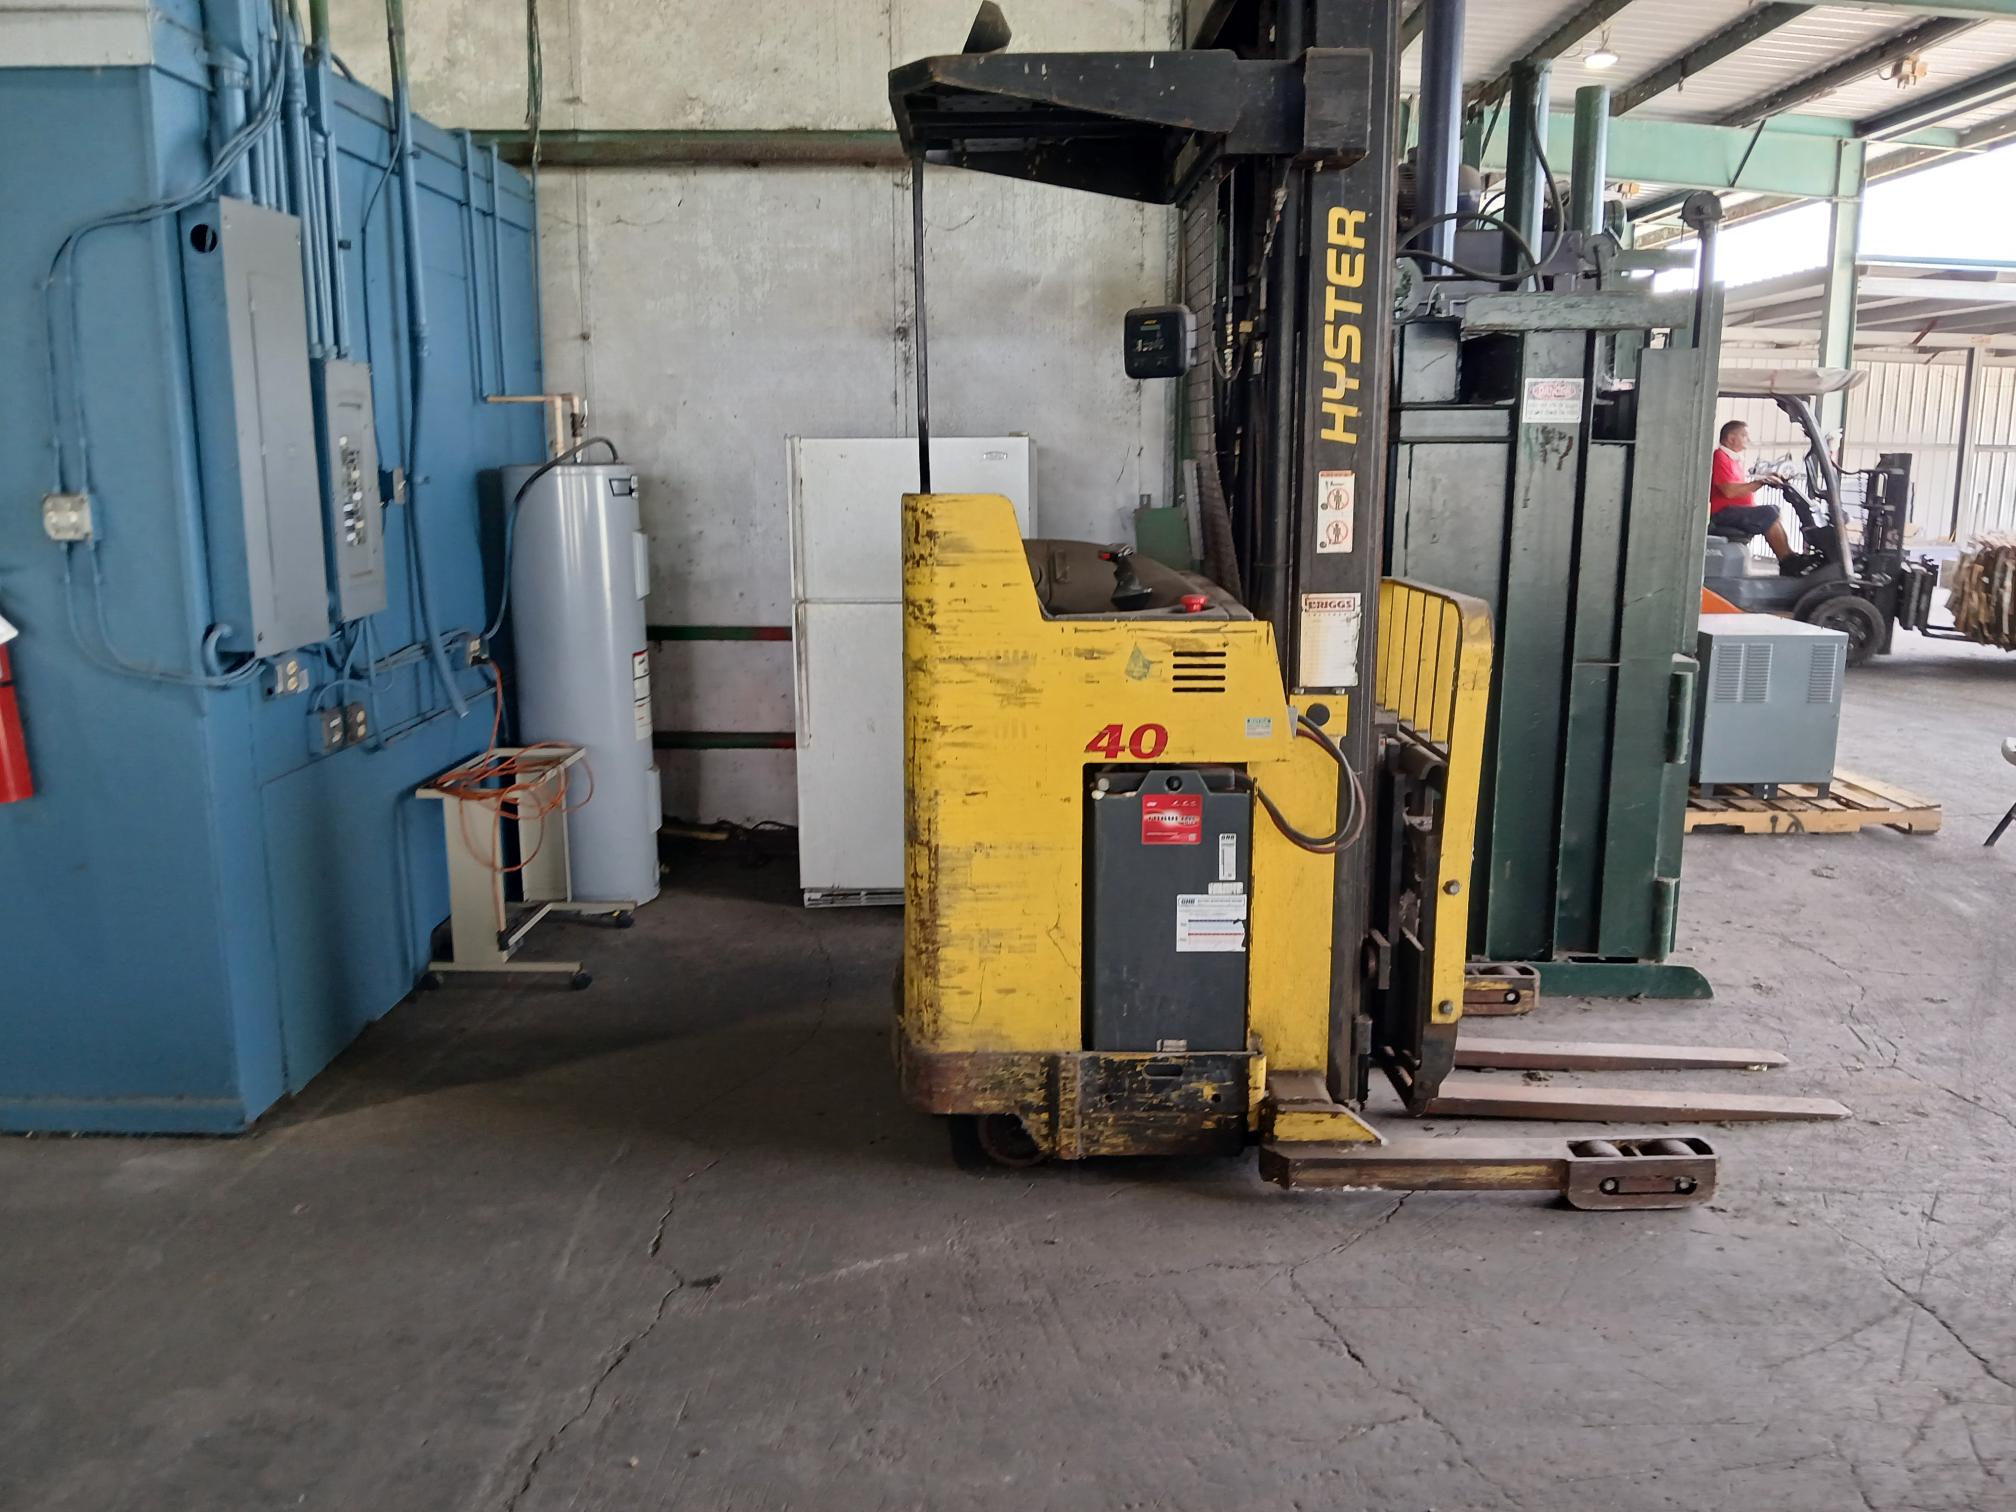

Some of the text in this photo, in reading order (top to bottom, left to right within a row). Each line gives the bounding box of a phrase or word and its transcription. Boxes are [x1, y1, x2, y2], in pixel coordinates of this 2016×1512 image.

[1320, 206, 1367, 445] HYSTER
[1308, 600, 1352, 609] BRIGGS
[1083, 722, 1169, 760] 40
